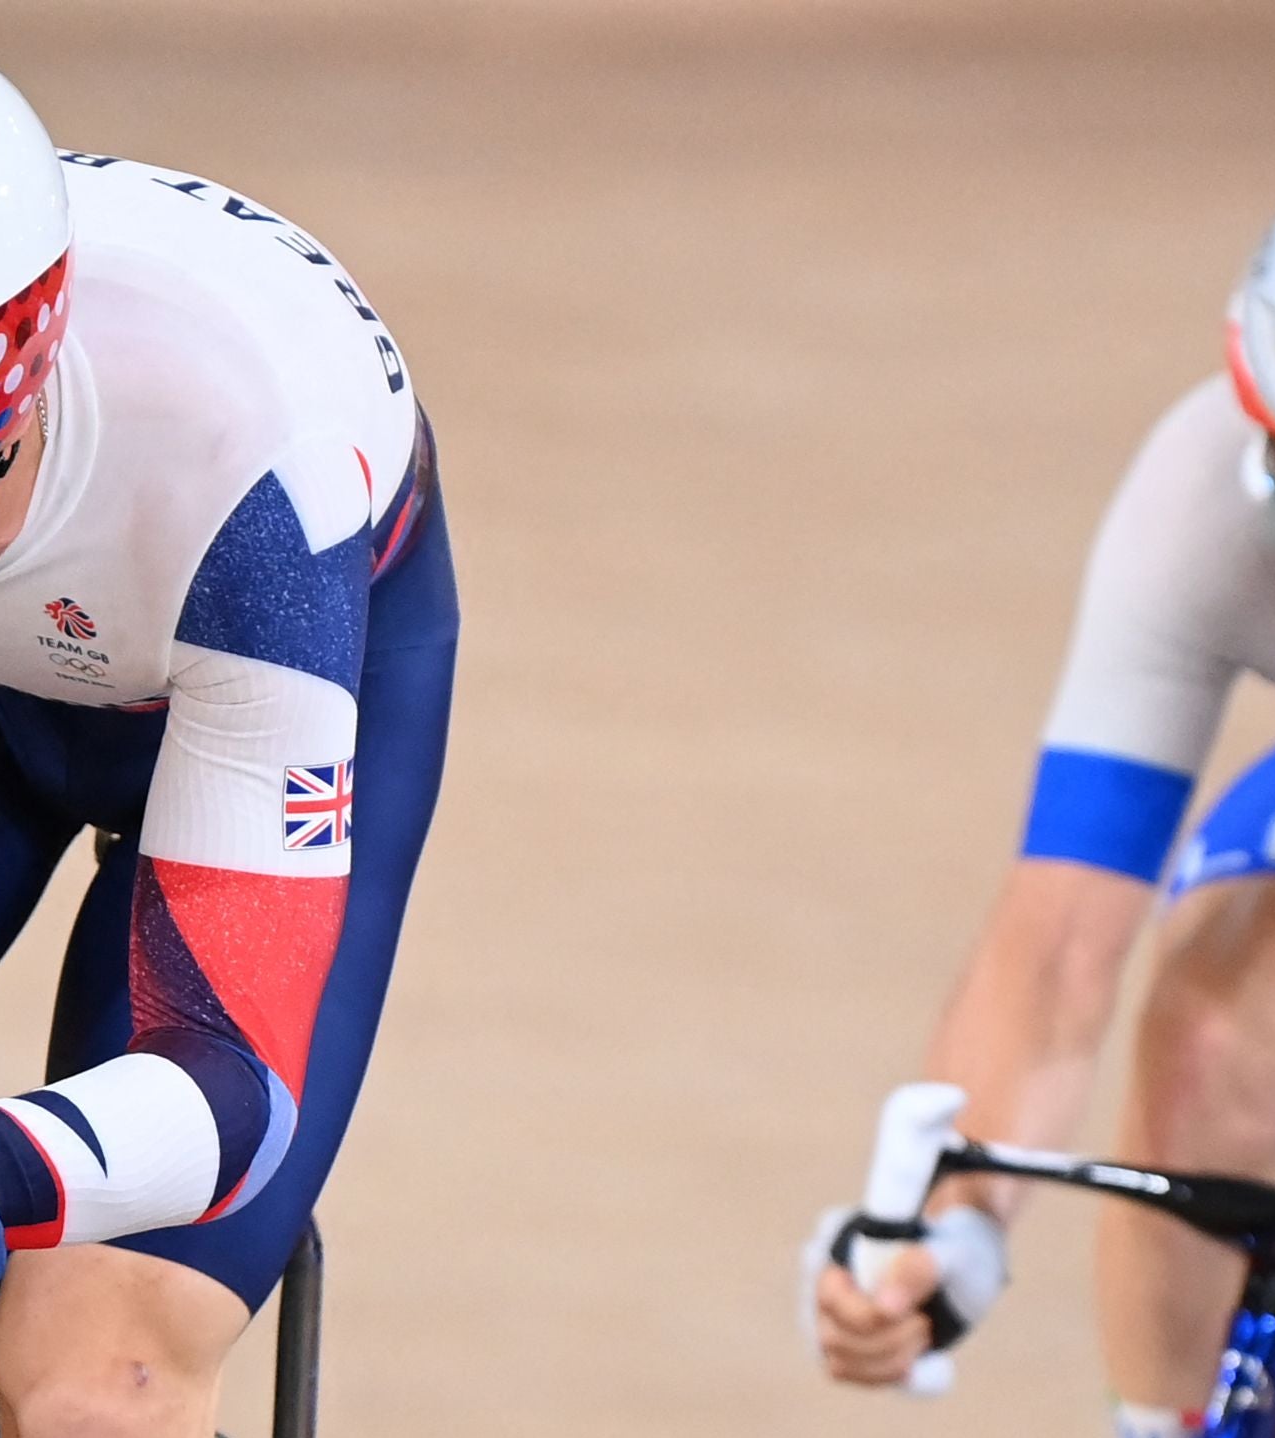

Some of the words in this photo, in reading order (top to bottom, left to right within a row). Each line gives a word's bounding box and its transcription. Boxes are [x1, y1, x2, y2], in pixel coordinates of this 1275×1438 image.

[150, 178, 404, 394] GREAT
[37, 635, 83, 656] TEAM
[87, 650, 110, 664] GB
